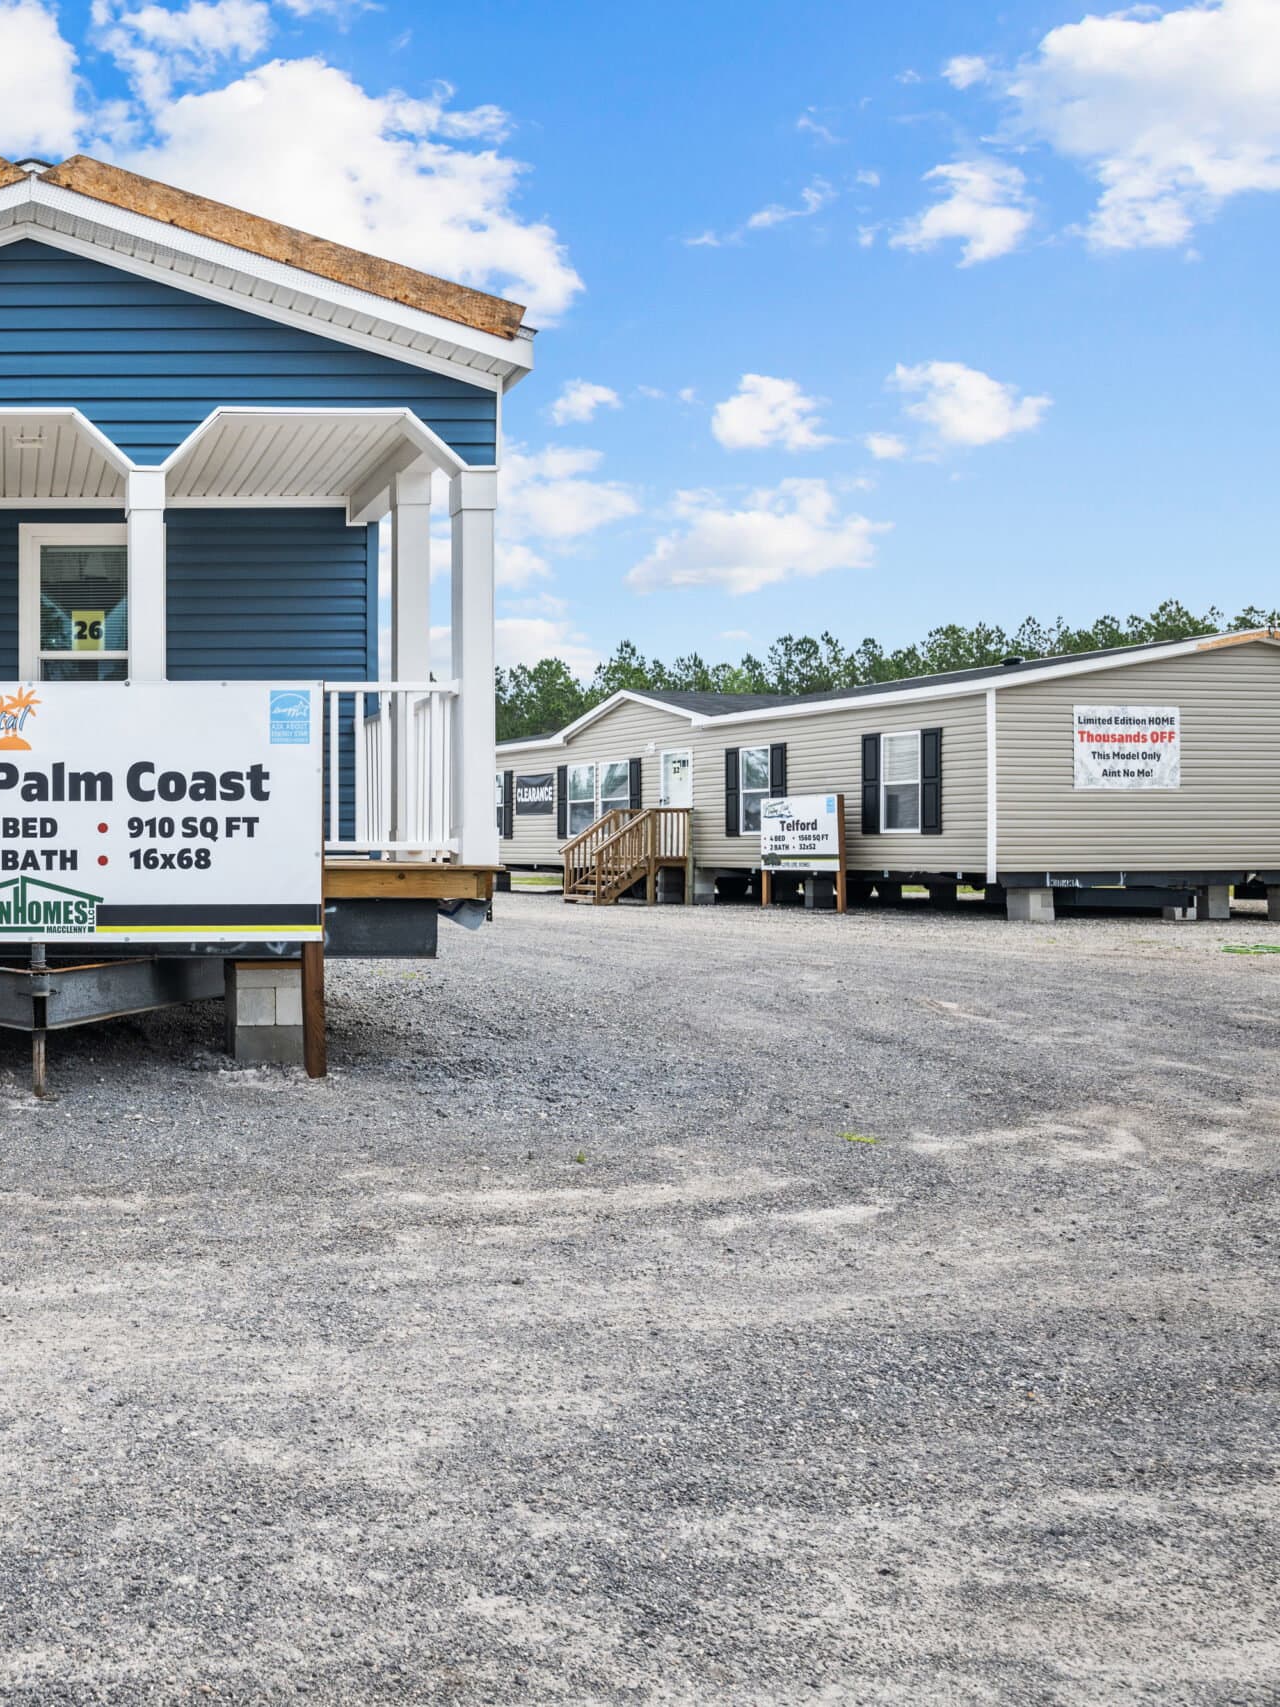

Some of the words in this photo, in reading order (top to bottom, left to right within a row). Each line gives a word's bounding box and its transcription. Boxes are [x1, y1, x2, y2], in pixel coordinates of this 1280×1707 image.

[74, 621, 104, 640] 26
[1077, 716, 1113, 726] Limited
[1114, 716, 1147, 726] Edition
[1148, 717, 1176, 726] HOME
[1078, 730, 1148, 743] Thousands
[1150, 731, 1176, 743] OFF
[1091, 751, 1111, 760] This
[1112, 751, 1140, 760] Model
[1141, 751, 1162, 762] Only
[1101, 768, 1121, 778] Aint
[1122, 768, 1136, 778] No
[1137, 768, 1154, 778] Mo!
[126, 761, 271, 802] Coast
[516, 785, 553, 803] CLEARANCE
[1, 816, 59, 839] BED
[127, 816, 176, 839] 910
[181, 816, 220, 843] SQ
[225, 816, 261, 839] FT
[779, 818, 818, 832] Telford
[821, 833, 829, 841] FT
[774, 843, 790, 851] BATH
[1, 849, 79, 871] BATH
[129, 847, 213, 870] 16x68
[88, 907, 96, 926] LLC
[46, 926, 88, 934] MACCLENNY
